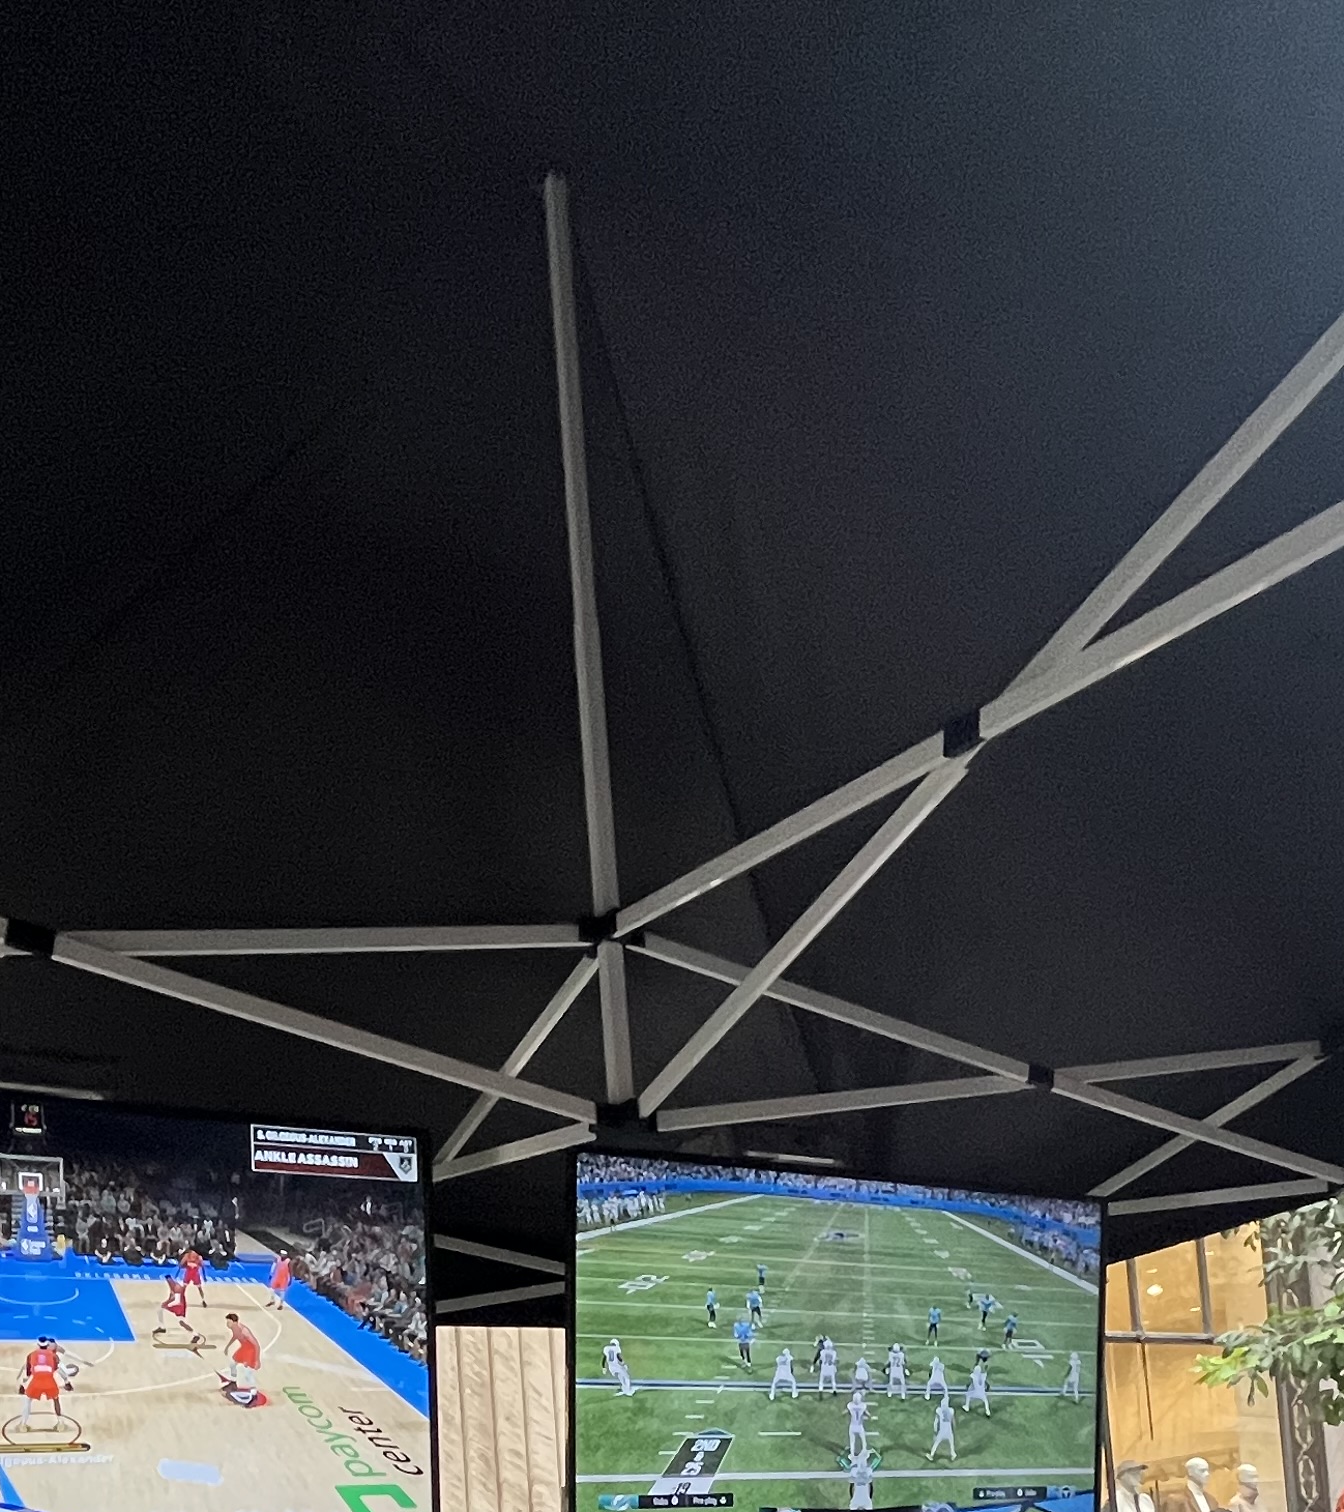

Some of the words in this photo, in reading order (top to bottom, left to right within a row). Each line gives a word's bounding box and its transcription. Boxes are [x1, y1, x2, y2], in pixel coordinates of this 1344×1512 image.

[254, 1149, 297, 1165] ANKLE
[298, 1155, 359, 1169] ASSASSIN
[282, 1386, 387, 1477] paycom
[337, 1405, 424, 1476] center
